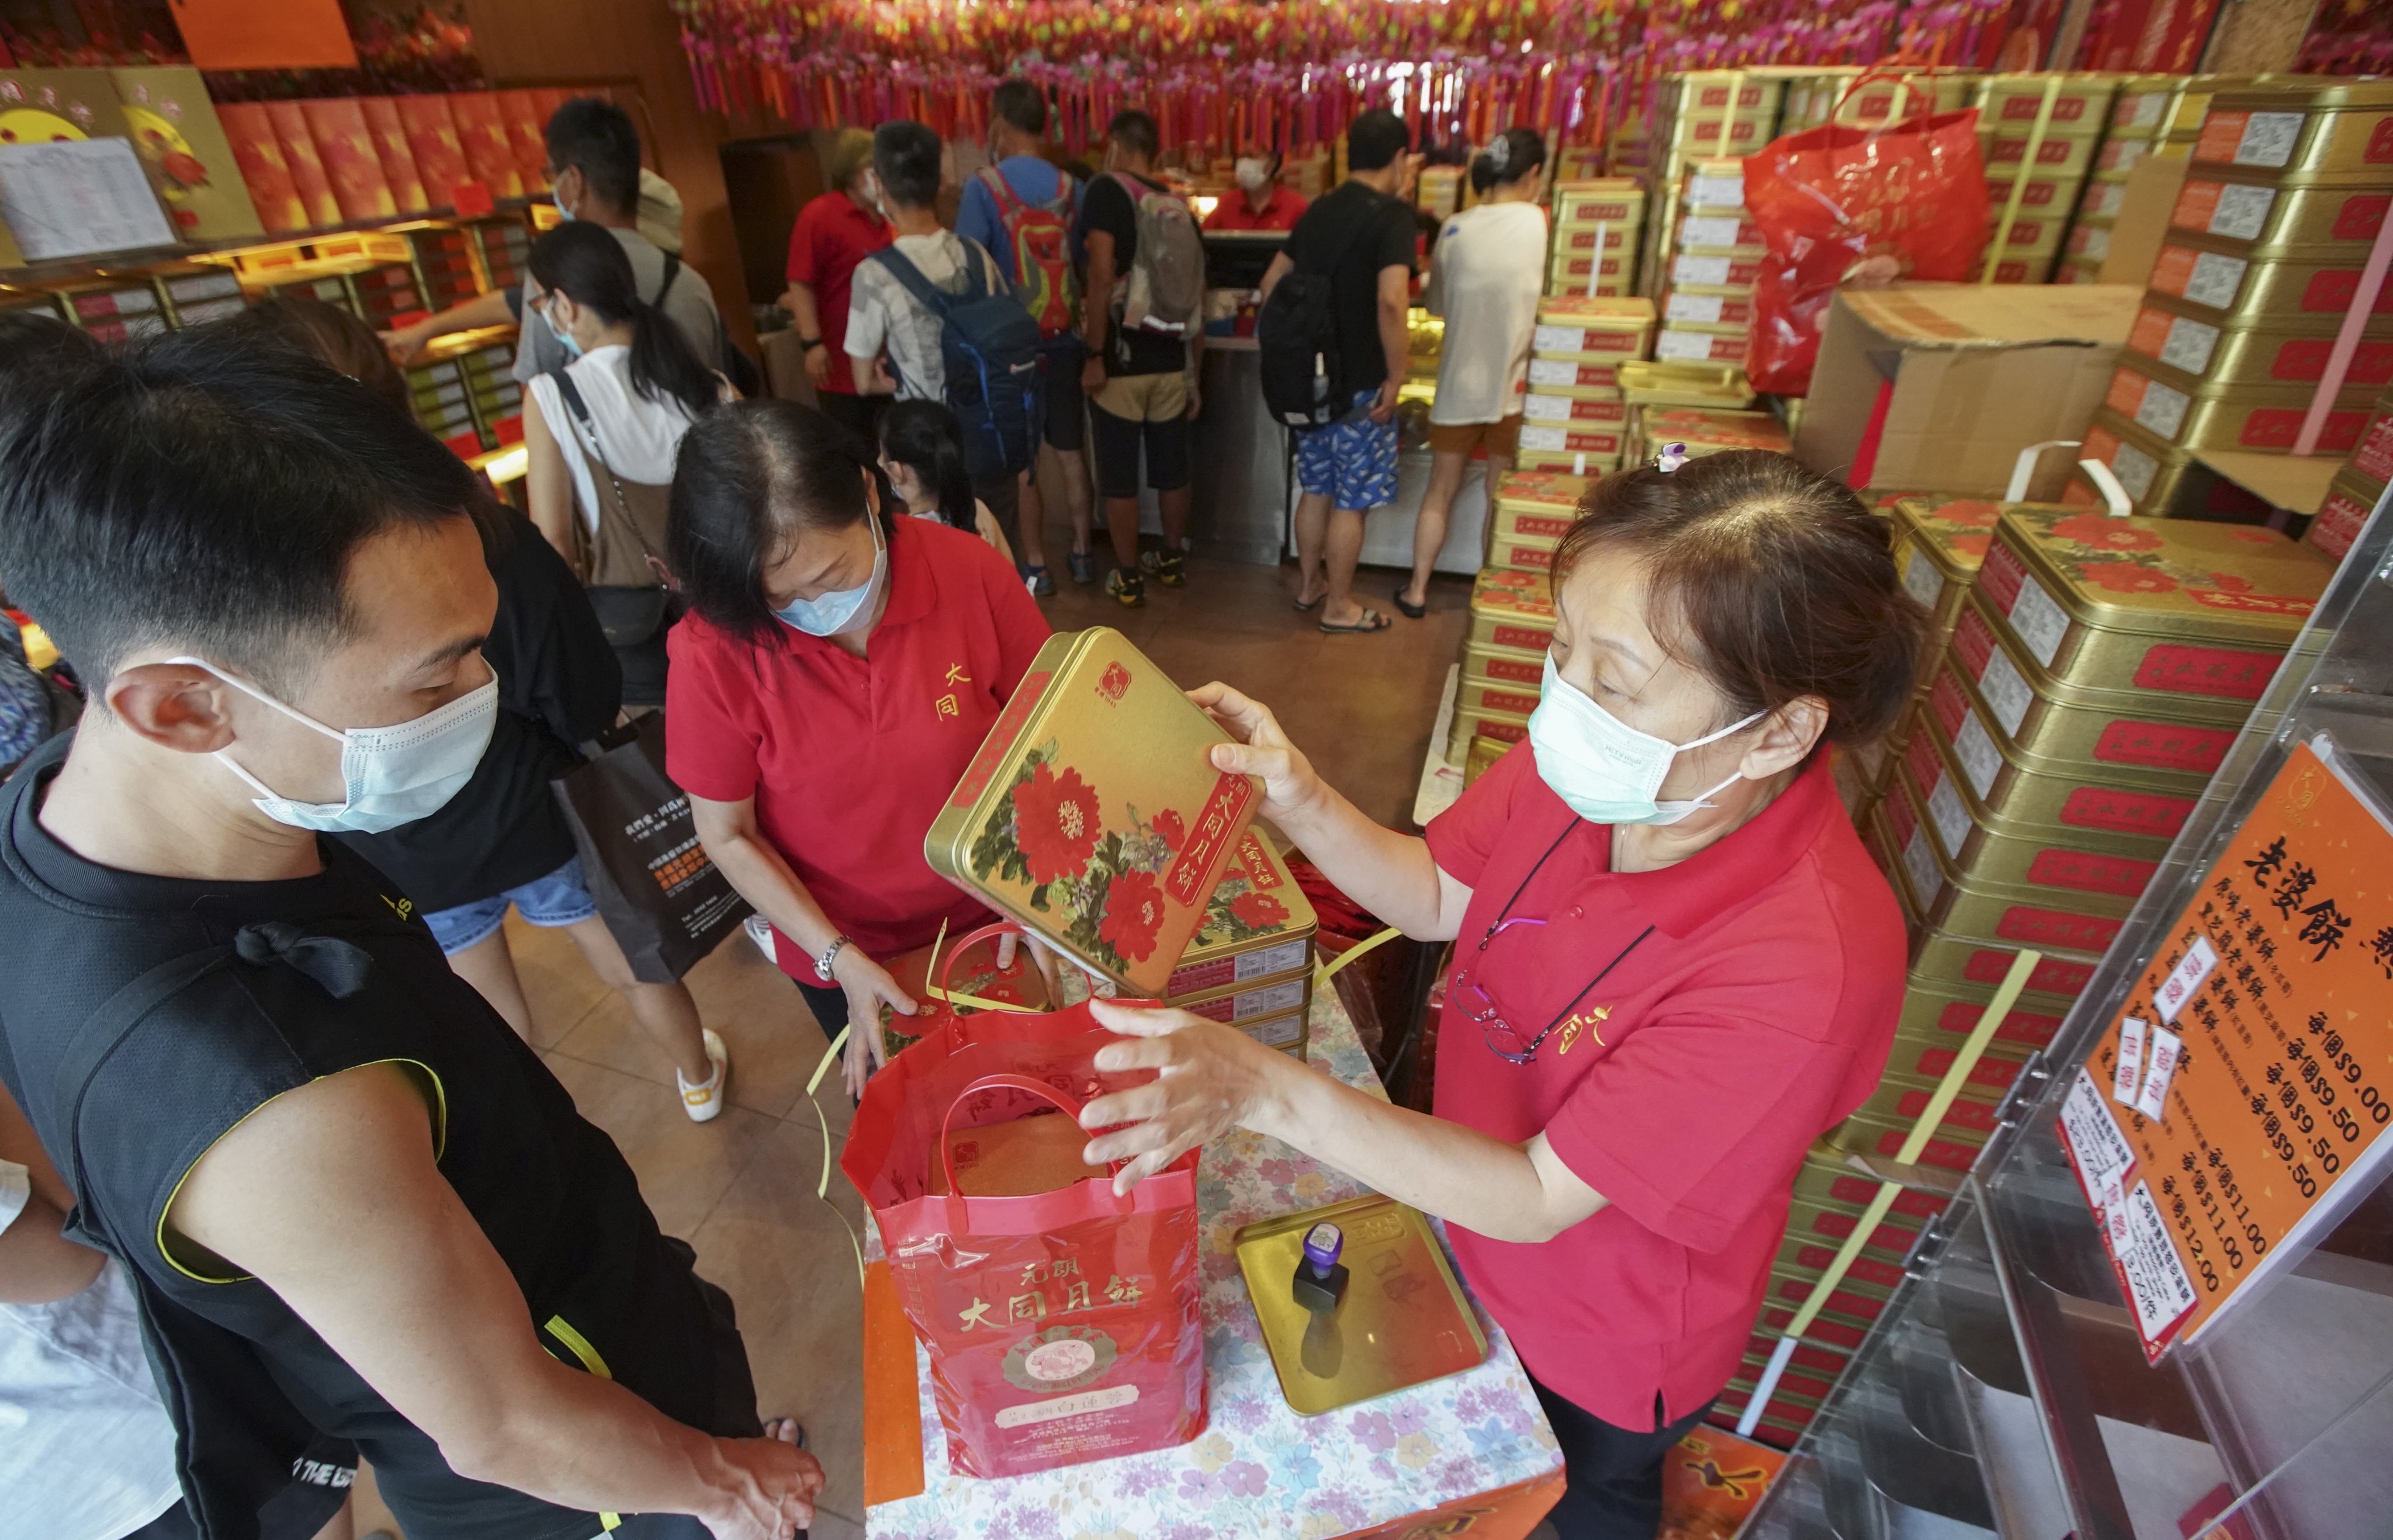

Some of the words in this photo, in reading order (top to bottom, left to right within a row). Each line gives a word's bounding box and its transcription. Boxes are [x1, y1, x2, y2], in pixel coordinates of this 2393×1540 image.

[936, 662, 971, 722] 大同
[1177, 790, 1234, 897] 大同月餅
[2244, 836, 2352, 963] 老婆餅
[1554, 1005, 1613, 1055] 大同
[2213, 877, 2277, 963] 原味老婆餅
[2308, 1011, 2391, 1124] 每個$9.00
[2266, 1062, 2340, 1174] 每個$9.50
[2287, 1038, 2360, 1143] 每個$9.50
[2251, 1093, 2317, 1198] 每個$9.50
[2162, 1175, 2219, 1292] 每個$12.00
[2183, 1151, 2243, 1270] 每個$11.00
[2208, 1148, 2266, 1255] 每個$11.00
[959, 1275, 1144, 1332] 大同月餅
[1020, 1257, 1079, 1286] 元朗
[300, 1459, 337, 1486] THE
